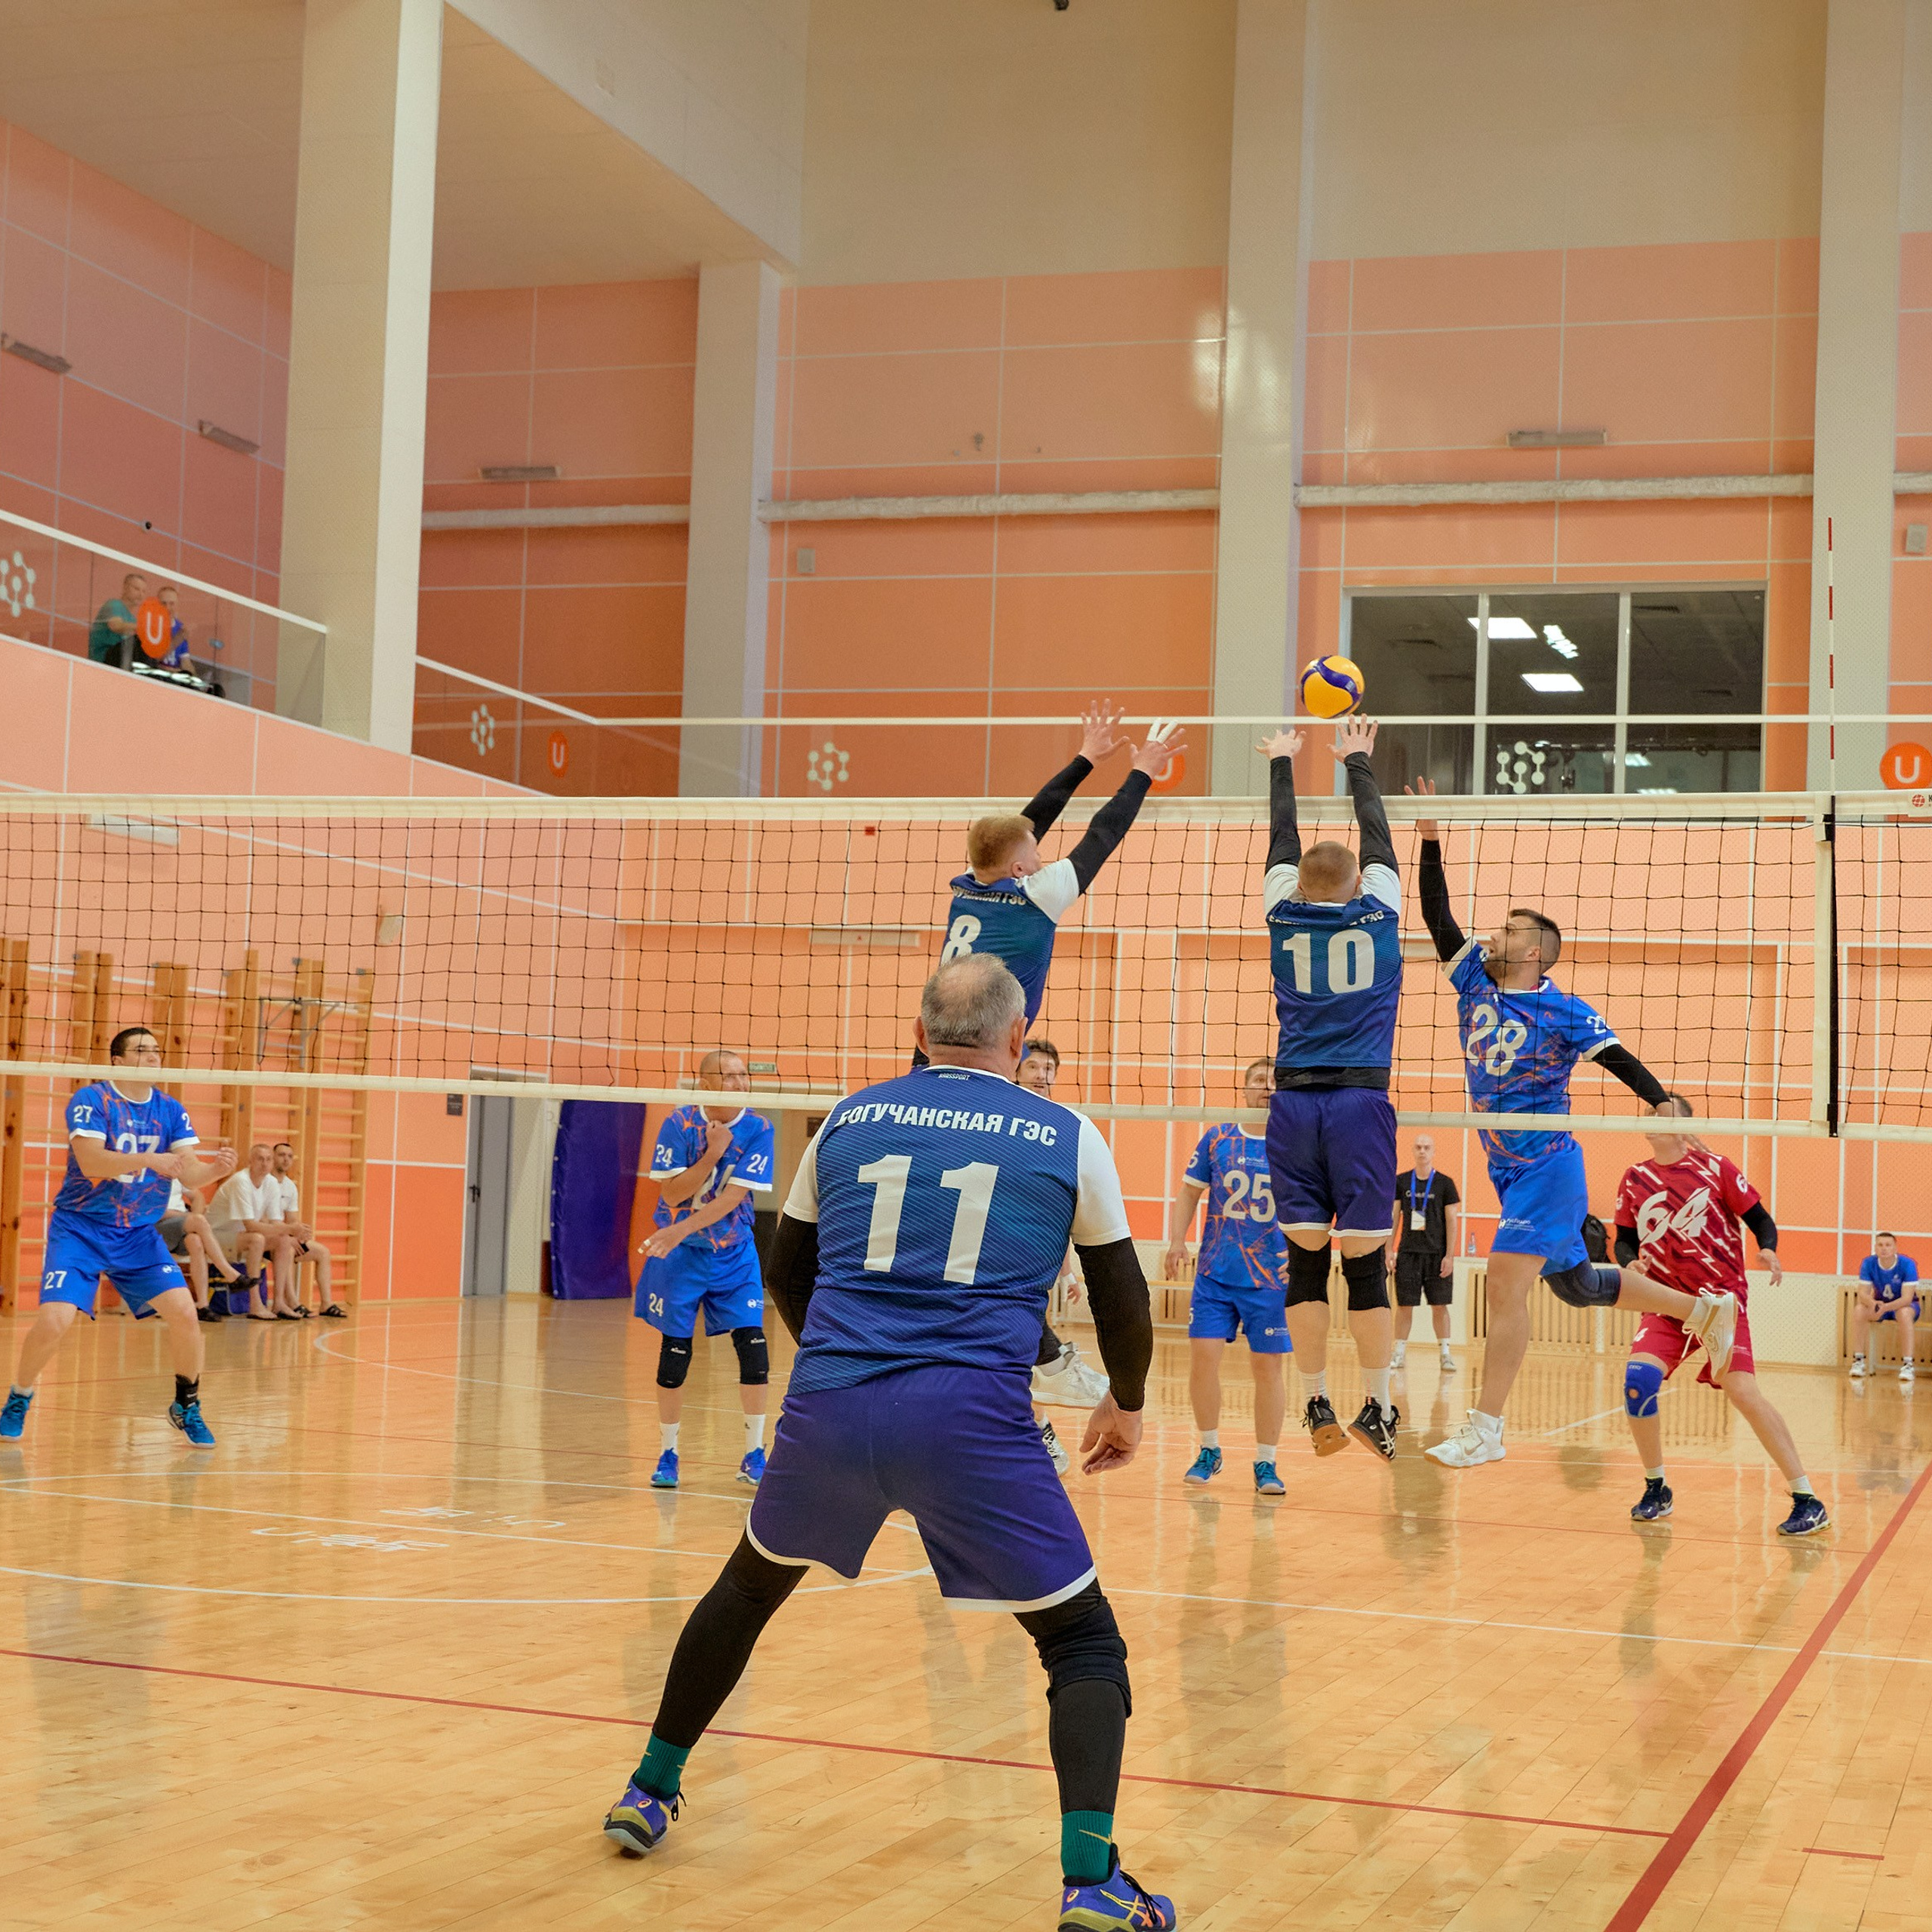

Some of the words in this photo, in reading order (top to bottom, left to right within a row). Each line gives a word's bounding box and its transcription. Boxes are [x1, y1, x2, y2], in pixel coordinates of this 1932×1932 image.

[146, 611, 164, 645] U
[552, 742, 565, 768] U
[1895, 755, 1920, 784] U
[942, 915, 980, 966] 8
[1283, 929, 1375, 994] 10
[1466, 1004, 1527, 1076] 28
[73, 1105, 93, 1123] 27
[834, 1103, 1004, 1133] БОГУЧАНСКАЯ
[1009, 1118, 1057, 1146] ГЭС
[655, 1144, 673, 1167] 24
[746, 1154, 768, 1174] 24
[1223, 1169, 1276, 1223] 25
[857, 1155, 999, 1284] 11
[1638, 1186, 1710, 1246] 64
[45, 1270, 67, 1289] 27
[649, 1293, 663, 1317] 24
